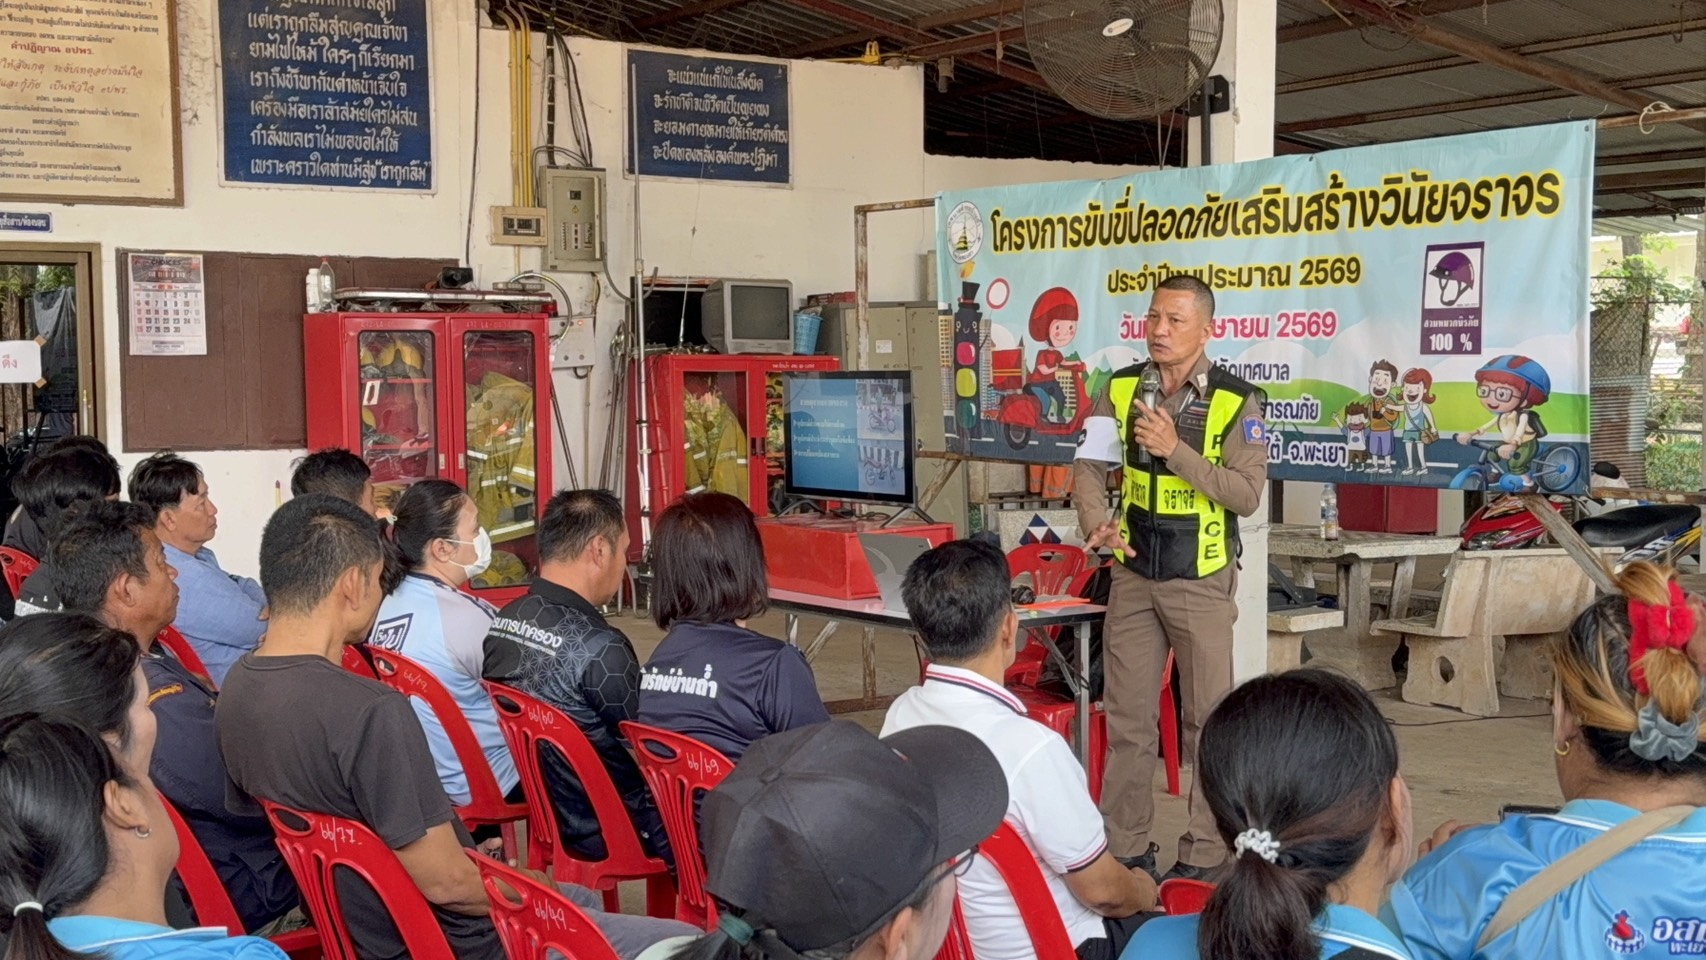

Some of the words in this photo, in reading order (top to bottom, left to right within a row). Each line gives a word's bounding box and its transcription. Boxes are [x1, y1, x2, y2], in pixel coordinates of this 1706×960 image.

[990, 172, 1560, 251] โครงการขับขี่ปลอดภัยเสริมสร้างวินัยจราจร
[1108, 264, 1290, 293] ประจำปีประมาณ
[1299, 257, 1361, 285] 2569
[1276, 312, 1337, 338] 2569
[1429, 333, 1453, 351] 100
[1670, 942, 1706, 953] พะเย
